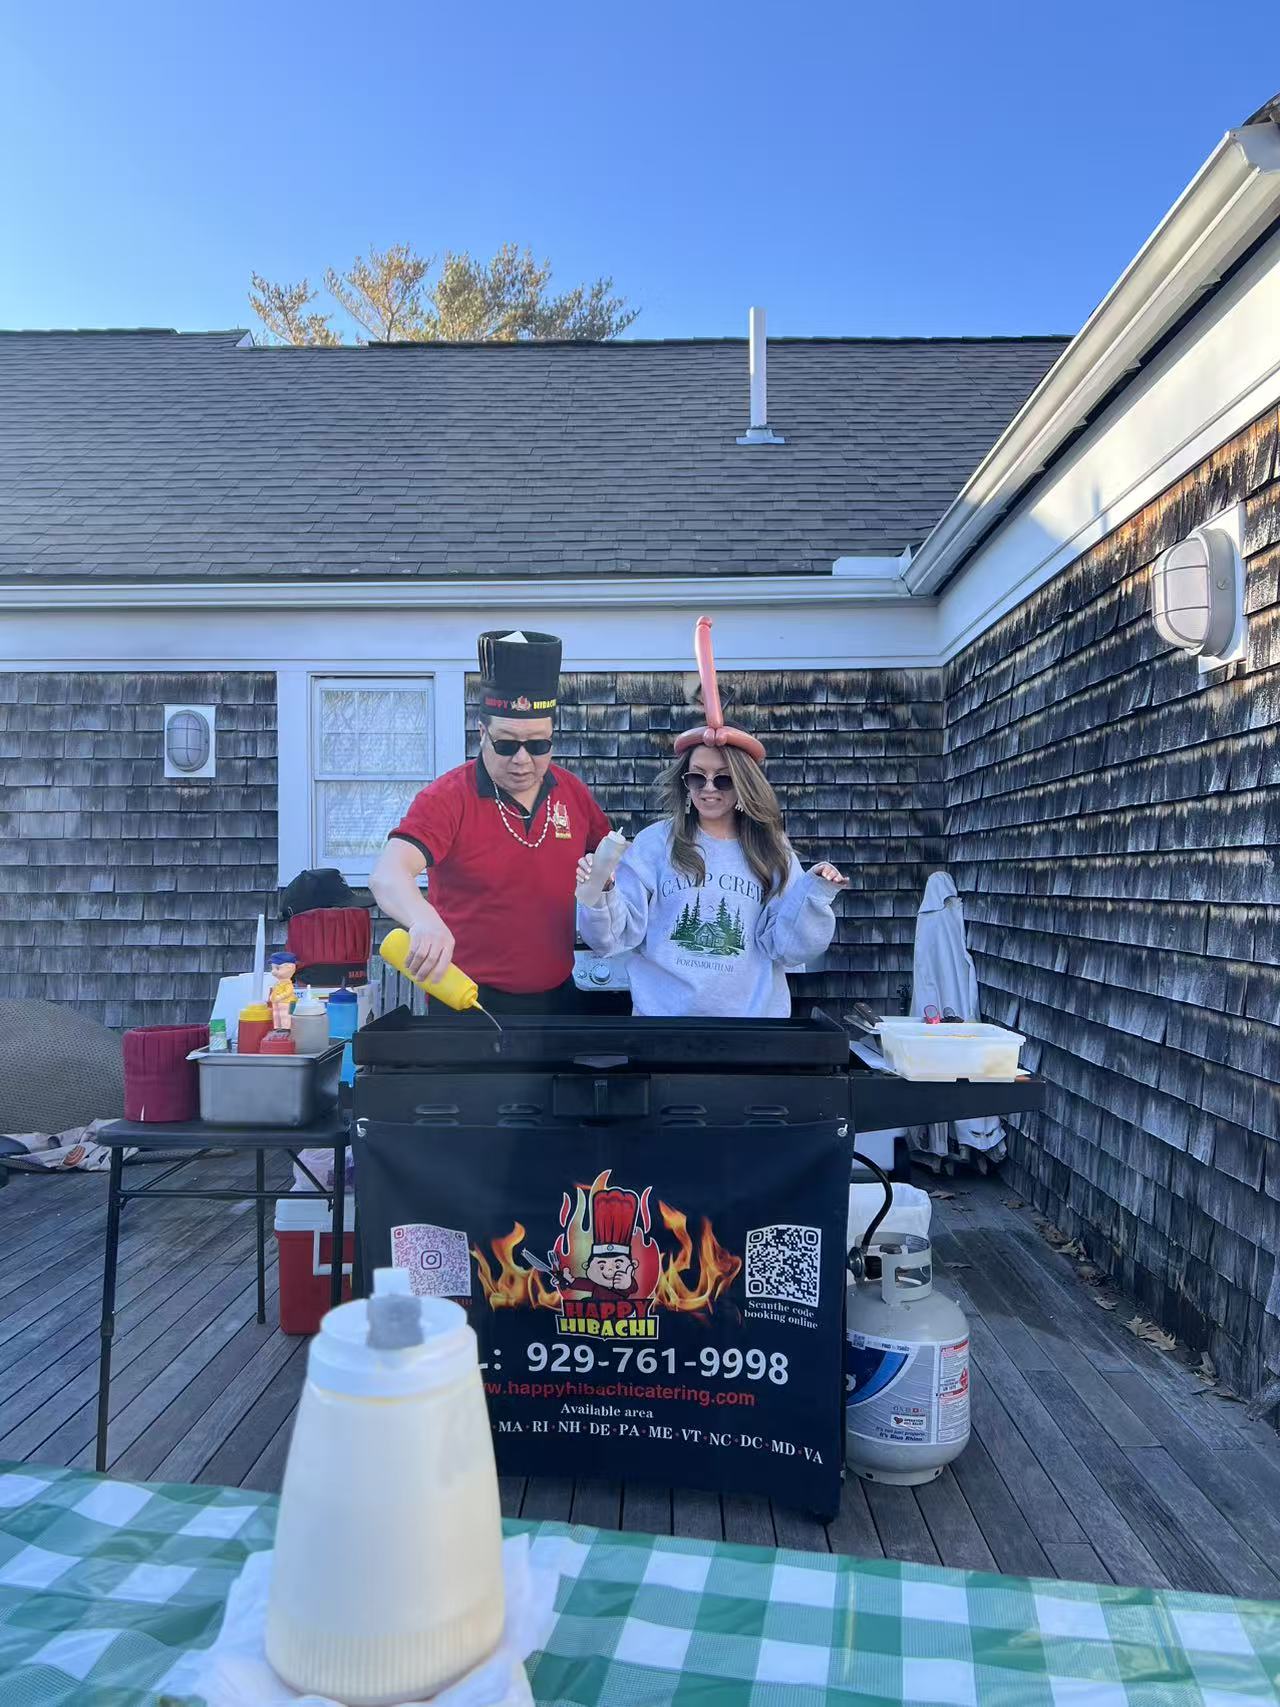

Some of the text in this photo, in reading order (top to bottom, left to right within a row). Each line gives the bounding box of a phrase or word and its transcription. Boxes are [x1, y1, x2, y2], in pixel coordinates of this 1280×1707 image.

[662, 872, 713, 897] CAMP
[565, 1302, 648, 1318] HAPPY
[744, 1309, 818, 1329] booking online
[792, 1307, 815, 1318] code
[560, 1318, 655, 1337] HIBACHI
[526, 1342, 789, 1385] 929-761-9998
[484, 1380, 756, 1407] w.happyhibachicatering.com
[560, 1403, 654, 1419] Available area
[498, 1421, 824, 1465] MA RI NH DE PA ME VT NC DC MD VA
